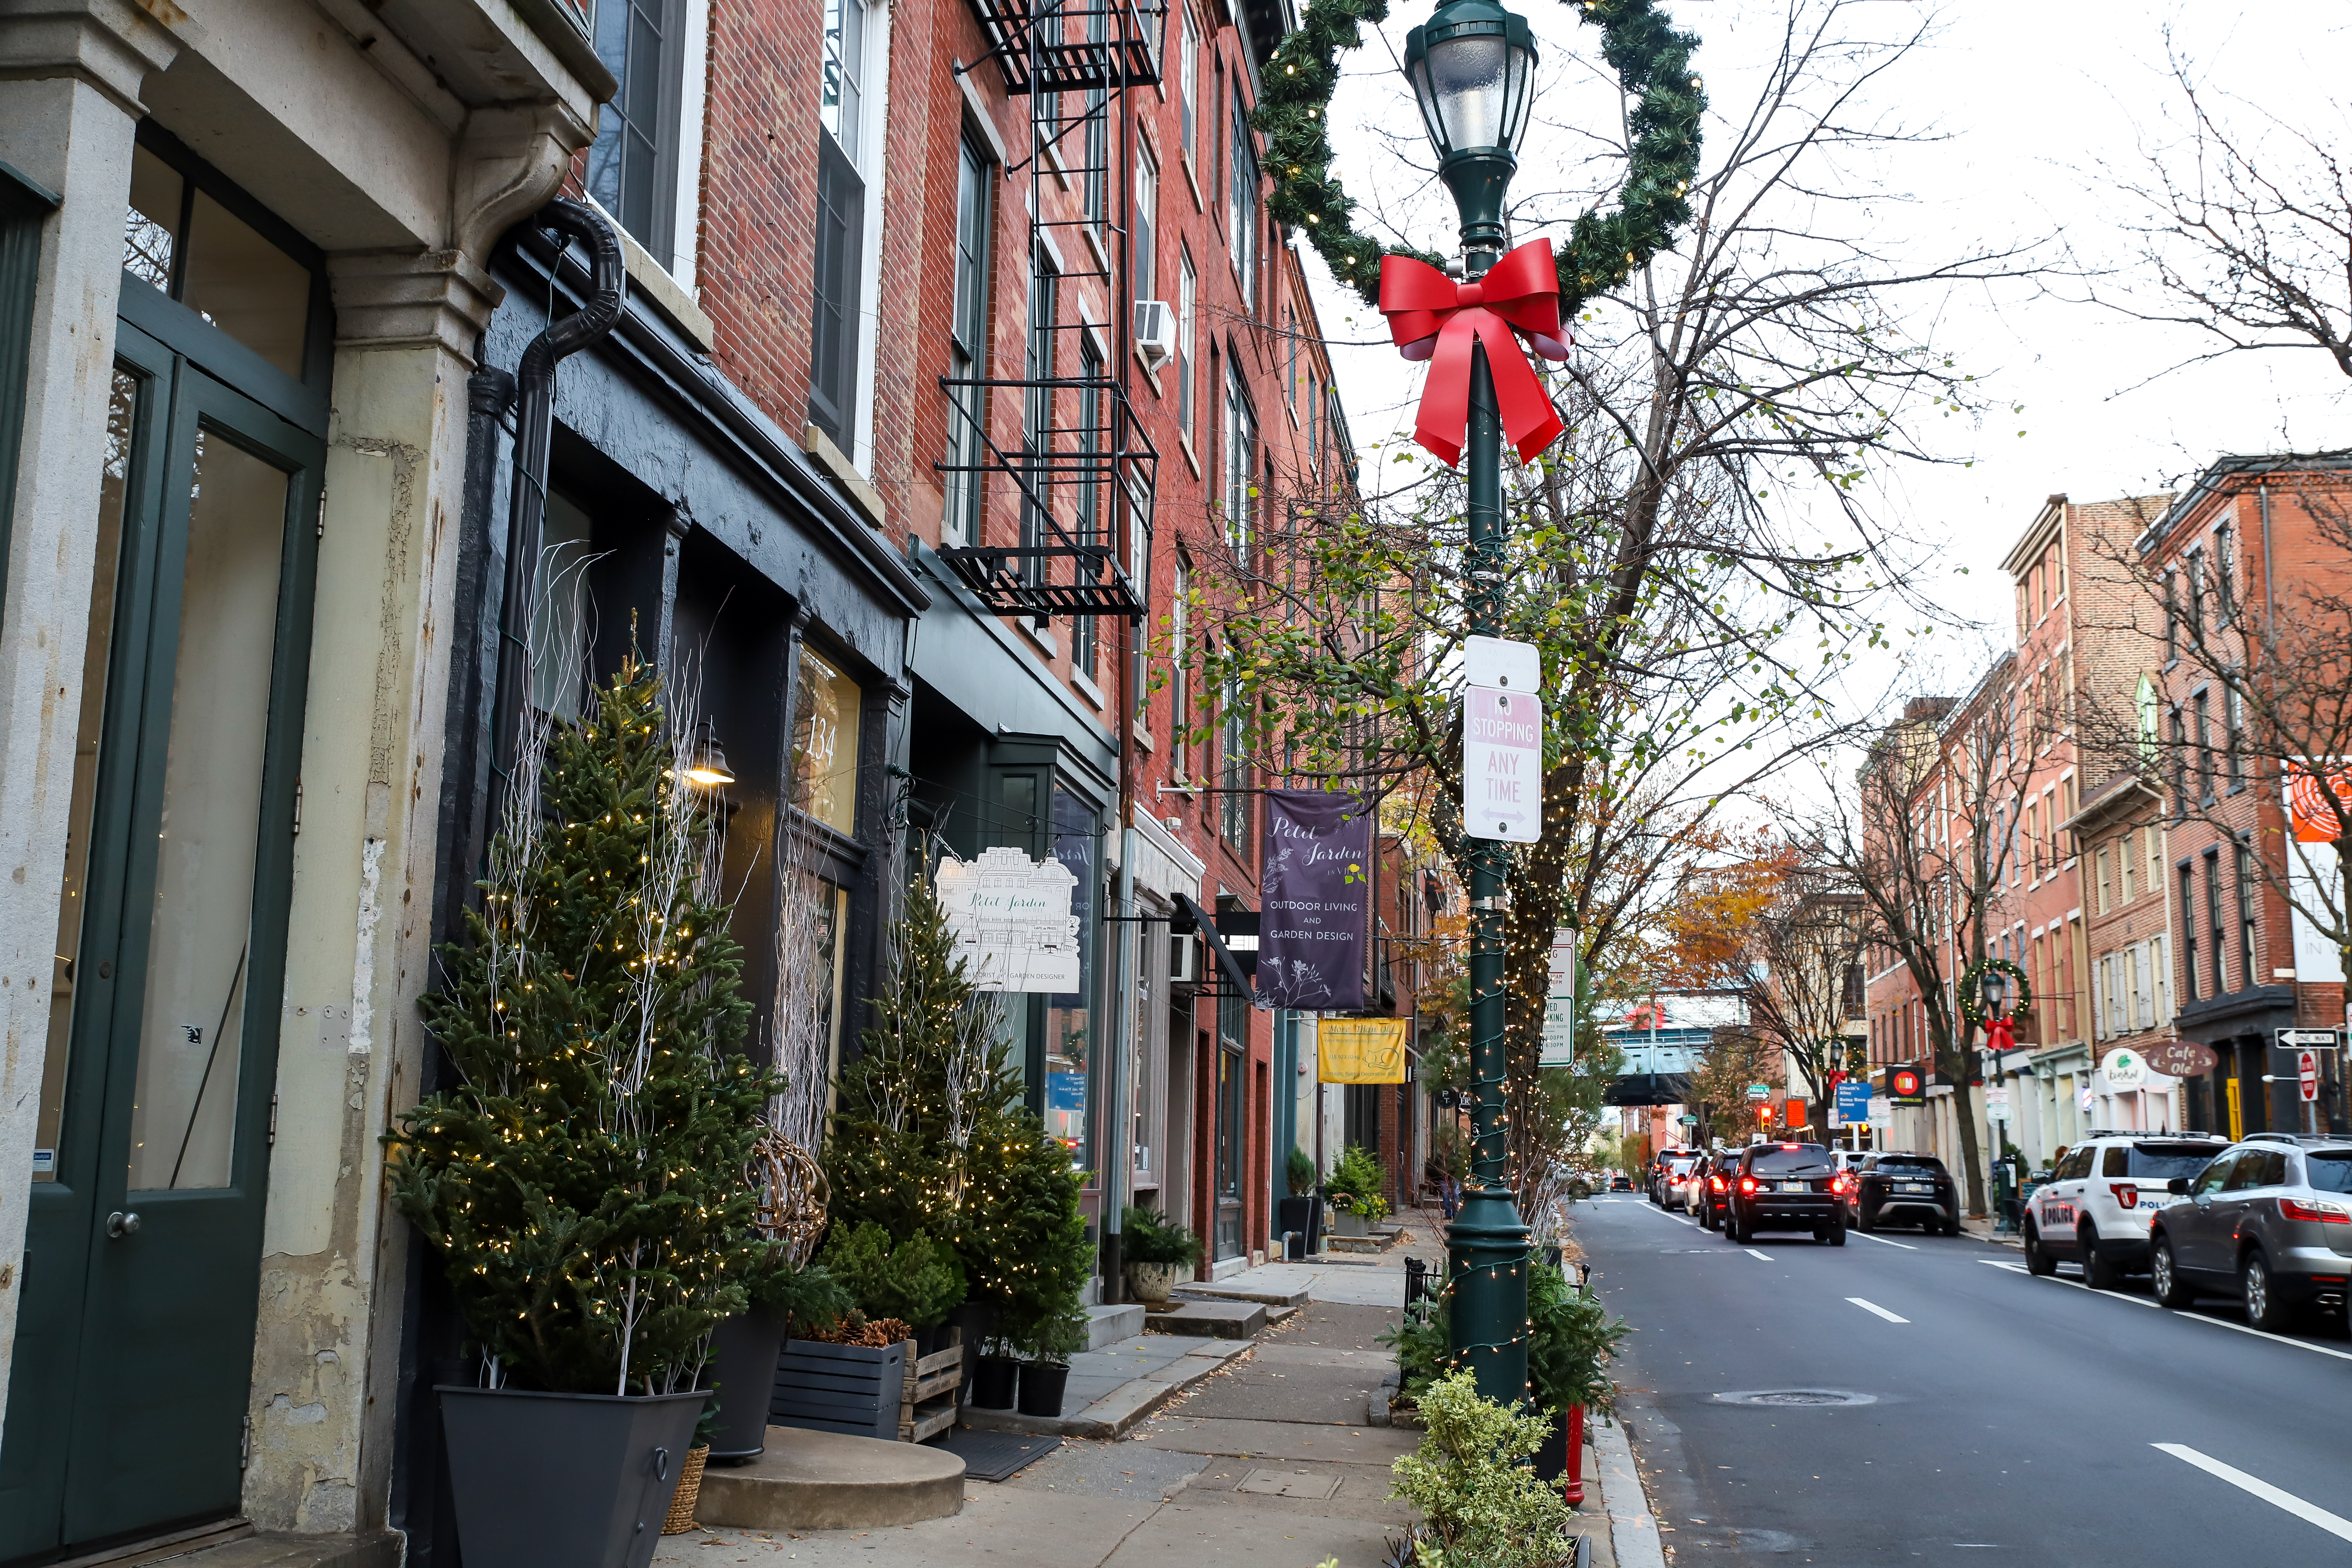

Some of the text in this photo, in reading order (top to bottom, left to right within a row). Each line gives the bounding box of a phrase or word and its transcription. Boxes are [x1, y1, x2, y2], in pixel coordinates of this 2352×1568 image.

[1494, 696, 1512, 716] NO
[807, 712, 836, 766] 134
[1473, 717, 1533, 743] STOPPING
[1487, 750, 1519, 776] ANY
[1485, 777, 1521, 804] TIME
[1266, 816, 1323, 839] Petit
[1302, 842, 1364, 866] Jardin
[967, 893, 1047, 911] Petit Jardin
[1270, 901, 1357, 912] OUTDOOR LIVING
[1270, 930, 1353, 941] GARDEN DESIGN
[1545, 1013, 1563, 1022] RKING
[1357, 1024, 1376, 1033] Than
[1380, 1024, 1395, 1033] Old
[2167, 1046, 2196, 1060] Cafe
